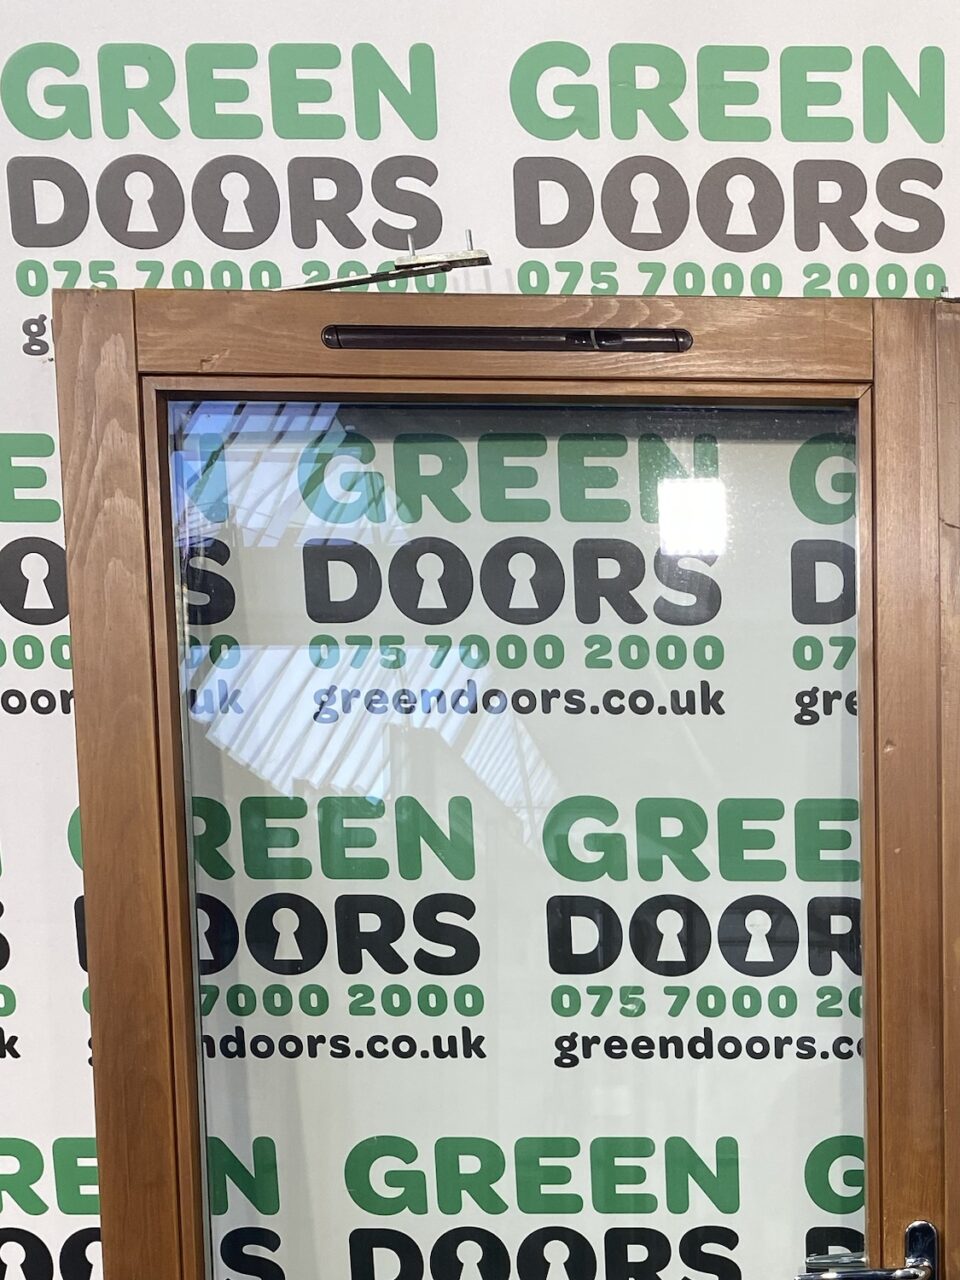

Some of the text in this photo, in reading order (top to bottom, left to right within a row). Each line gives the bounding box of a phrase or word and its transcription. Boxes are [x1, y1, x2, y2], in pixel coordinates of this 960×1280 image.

[0, 42, 438, 141] GREEN
[509, 41, 945, 143] GREEN
[5, 154, 443, 250] DOORS
[513, 155, 944, 252] DOORS
[16, 260, 117, 297] 075
[137, 260, 282, 289] 7000
[517, 260, 946, 297] 075 7000 2000
[303, 537, 722, 624] DOORS
[310, 634, 725, 671] 075 7000 2000
[313, 680, 725, 725] greendoors.co.uk
[346, 984, 485, 1017] 2000
[551, 985, 646, 1018] 075
[663, 985, 798, 1018] 7000
[554, 1026, 864, 1068] greendoors.c
[343, 1134, 740, 1216] GREEN
